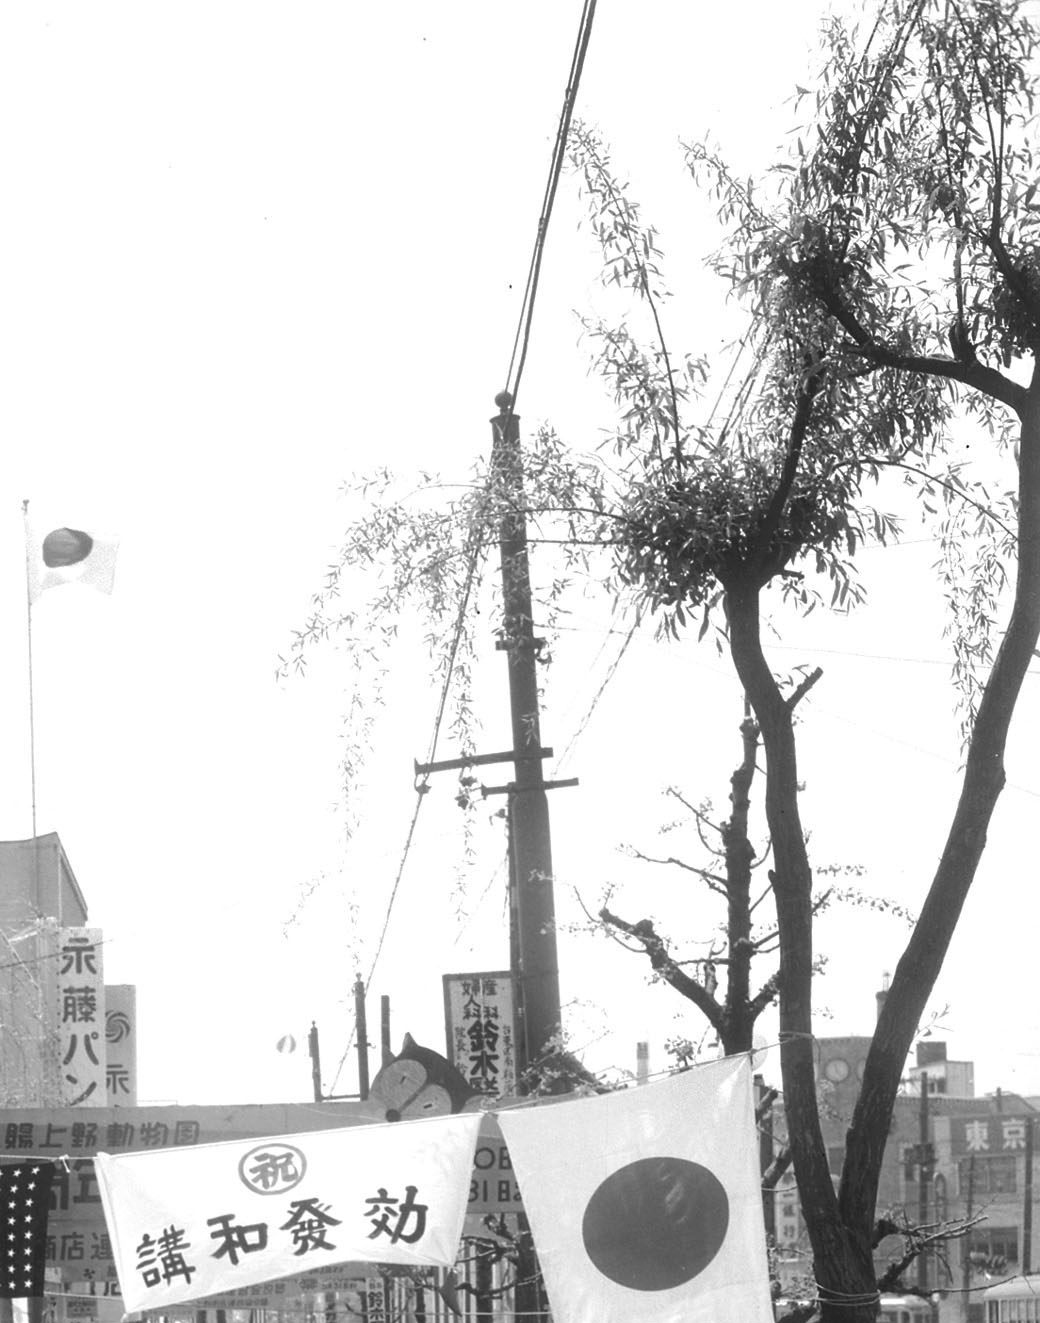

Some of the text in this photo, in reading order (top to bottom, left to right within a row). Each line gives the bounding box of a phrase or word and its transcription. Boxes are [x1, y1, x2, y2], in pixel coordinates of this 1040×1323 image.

[60, 937, 100, 1106] 永藤パン
[964, 1118, 1026, 1152] 東京
[248, 1151, 299, 1189] 祝
